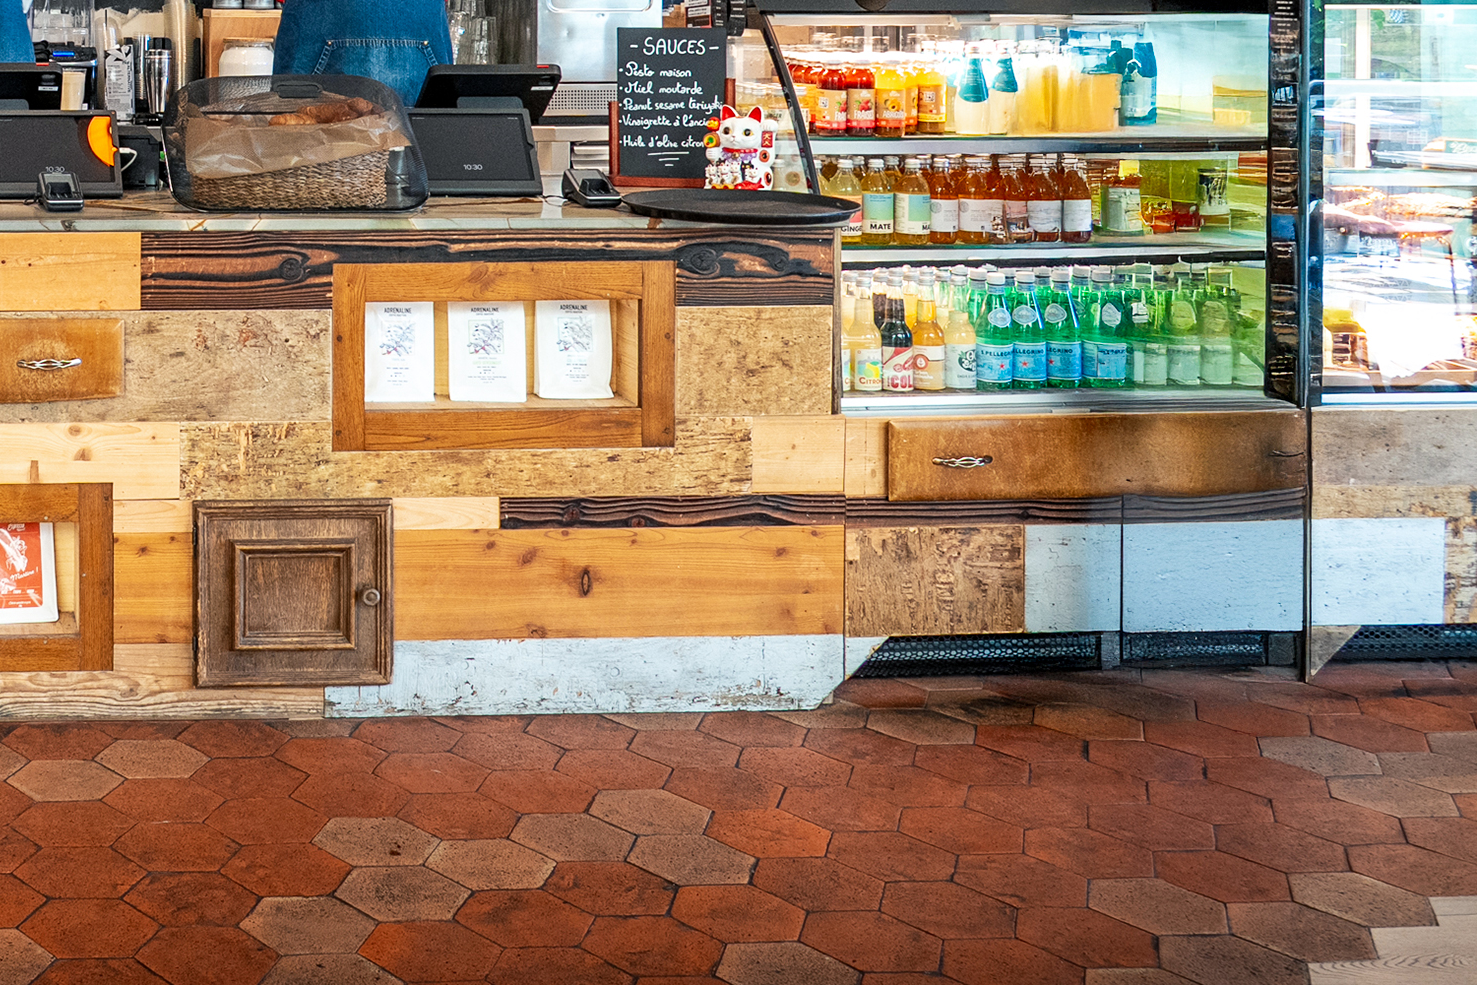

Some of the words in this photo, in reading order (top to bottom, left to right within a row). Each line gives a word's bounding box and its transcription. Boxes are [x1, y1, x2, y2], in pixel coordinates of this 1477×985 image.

[643, 37, 705, 55] SAUCES
[625, 61, 654, 76] Pesto
[660, 69, 691, 77] maison
[659, 81, 703, 94] moutarde
[623, 98, 653, 110] Peanut
[623, 135, 645, 147] Huile
[560, 304, 587, 312] ADRENALINE
